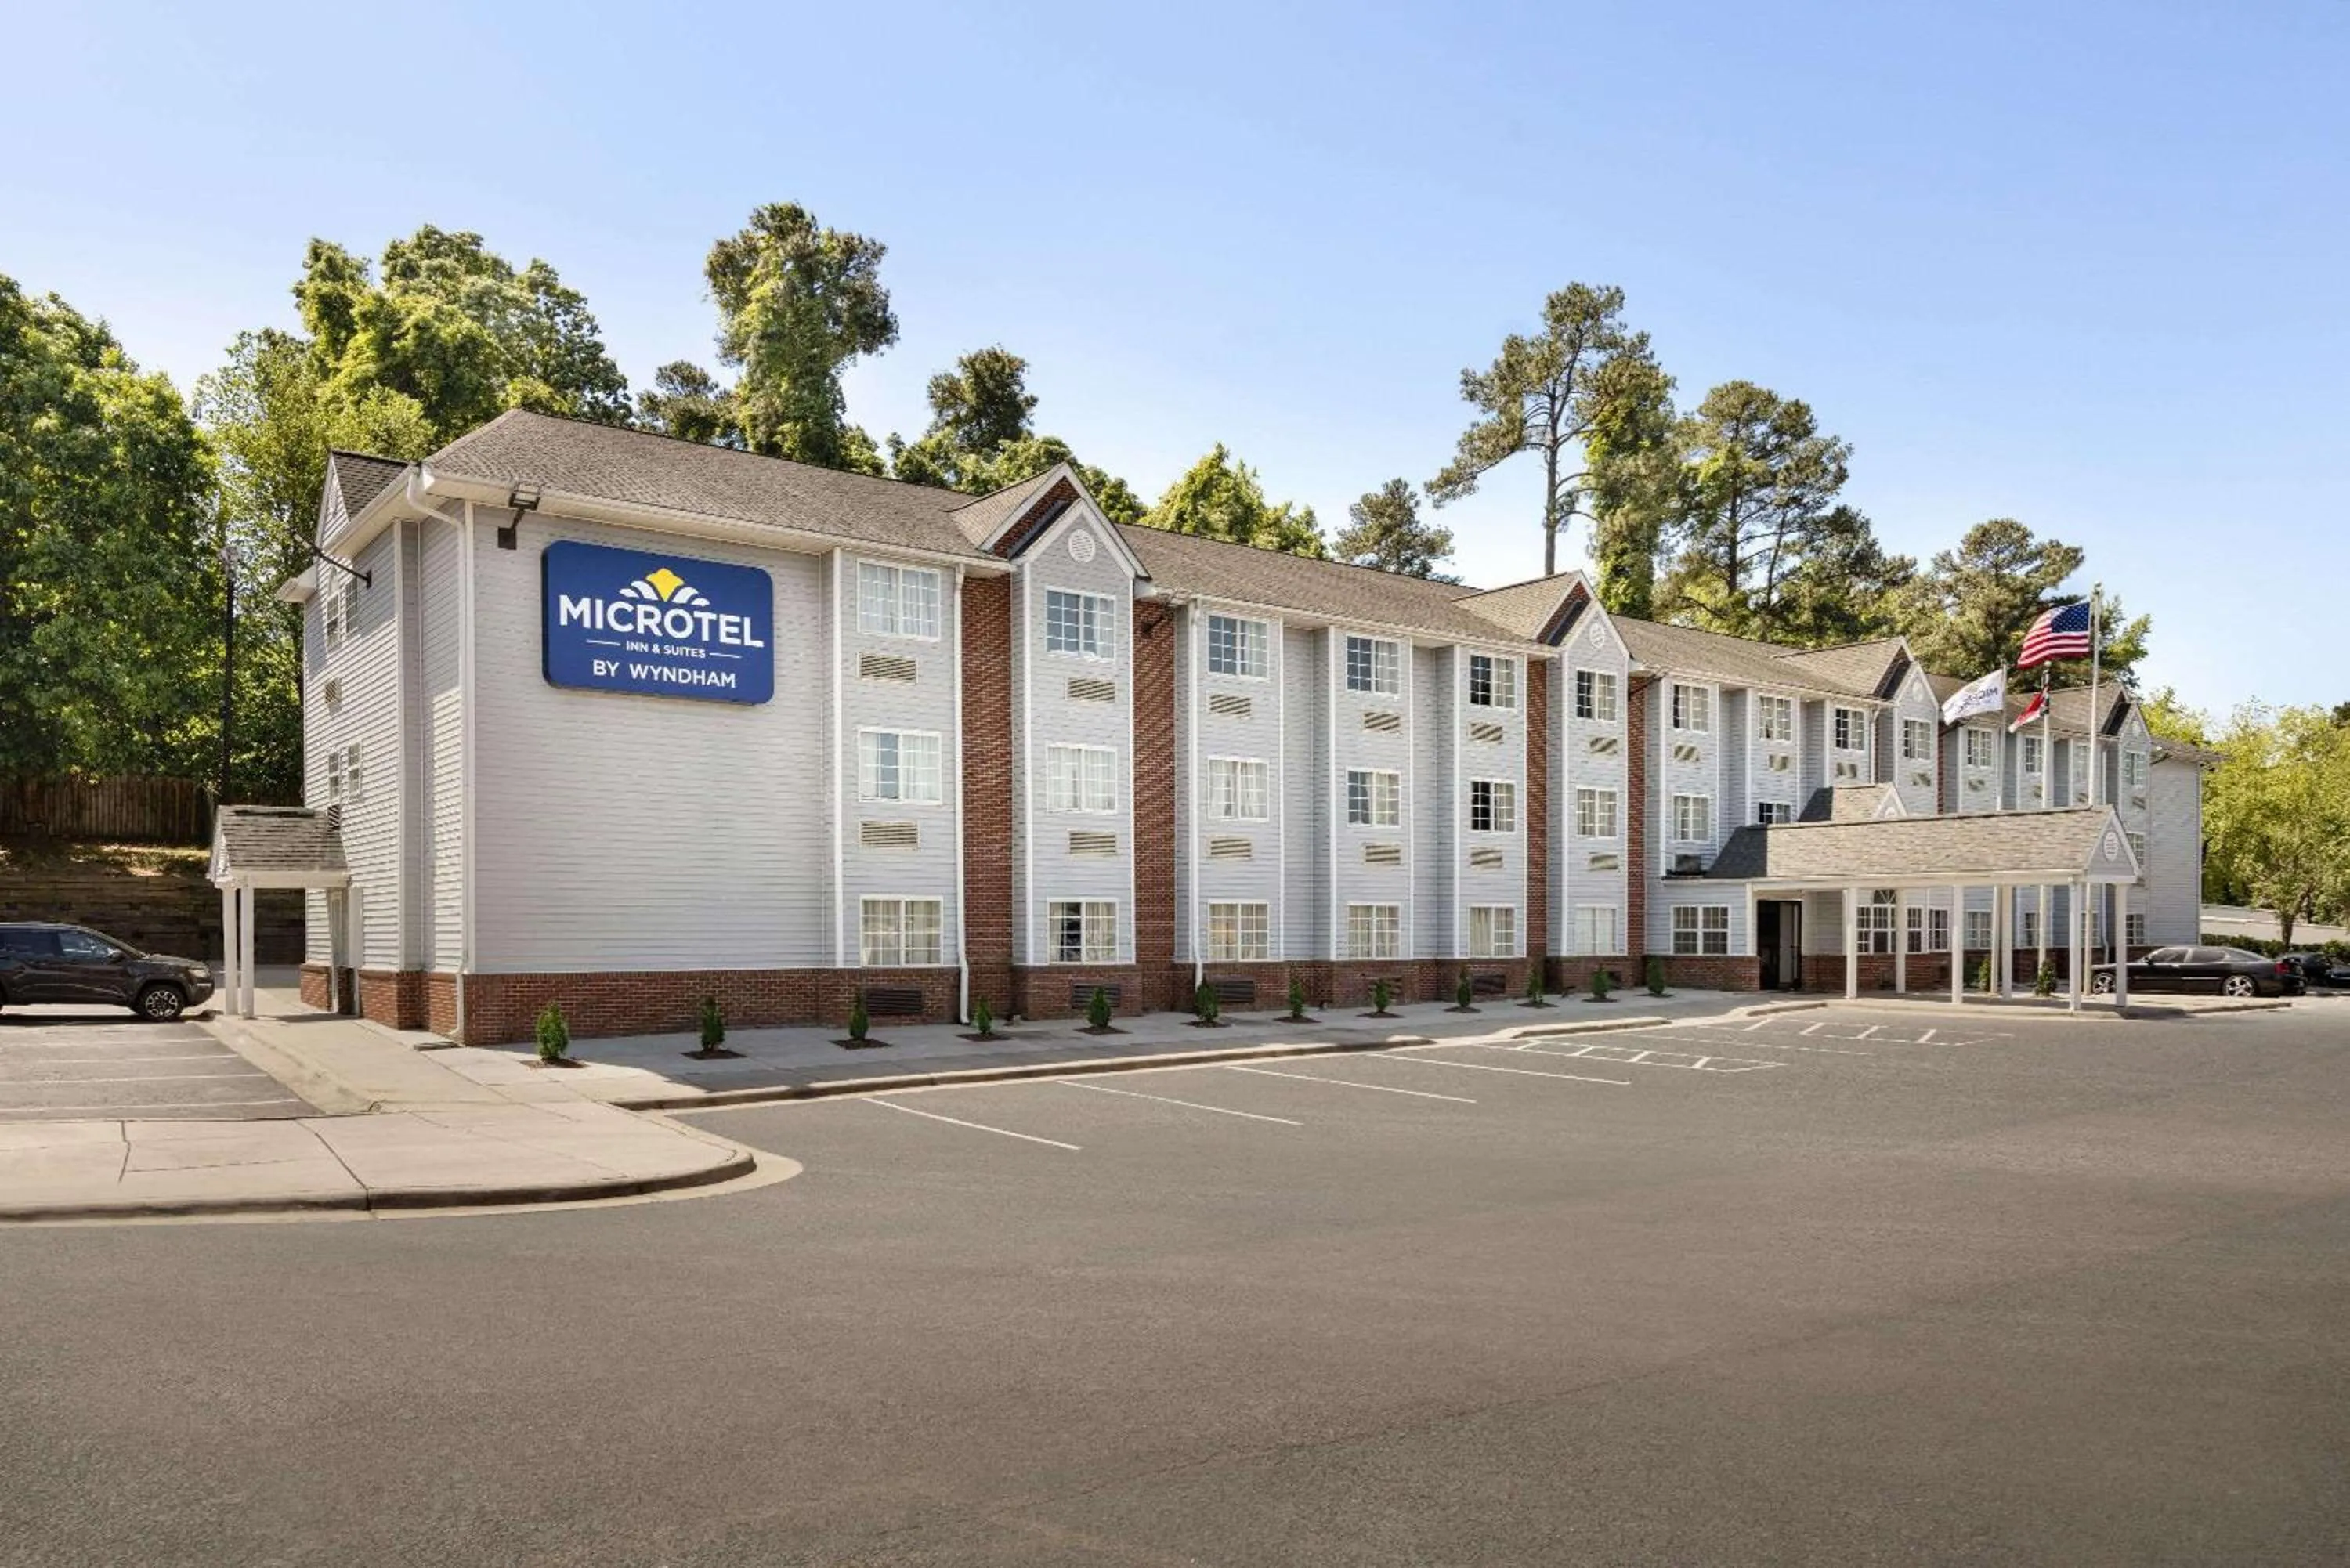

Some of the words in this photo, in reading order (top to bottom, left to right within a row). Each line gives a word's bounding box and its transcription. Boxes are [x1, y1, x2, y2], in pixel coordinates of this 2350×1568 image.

[559, 594, 765, 648] MICROTEL
[626, 641, 649, 652] INN
[651, 643, 661, 654] &
[663, 645, 706, 659] SUITES
[593, 659, 620, 677] BY
[629, 663, 736, 688] WYNDHAM
